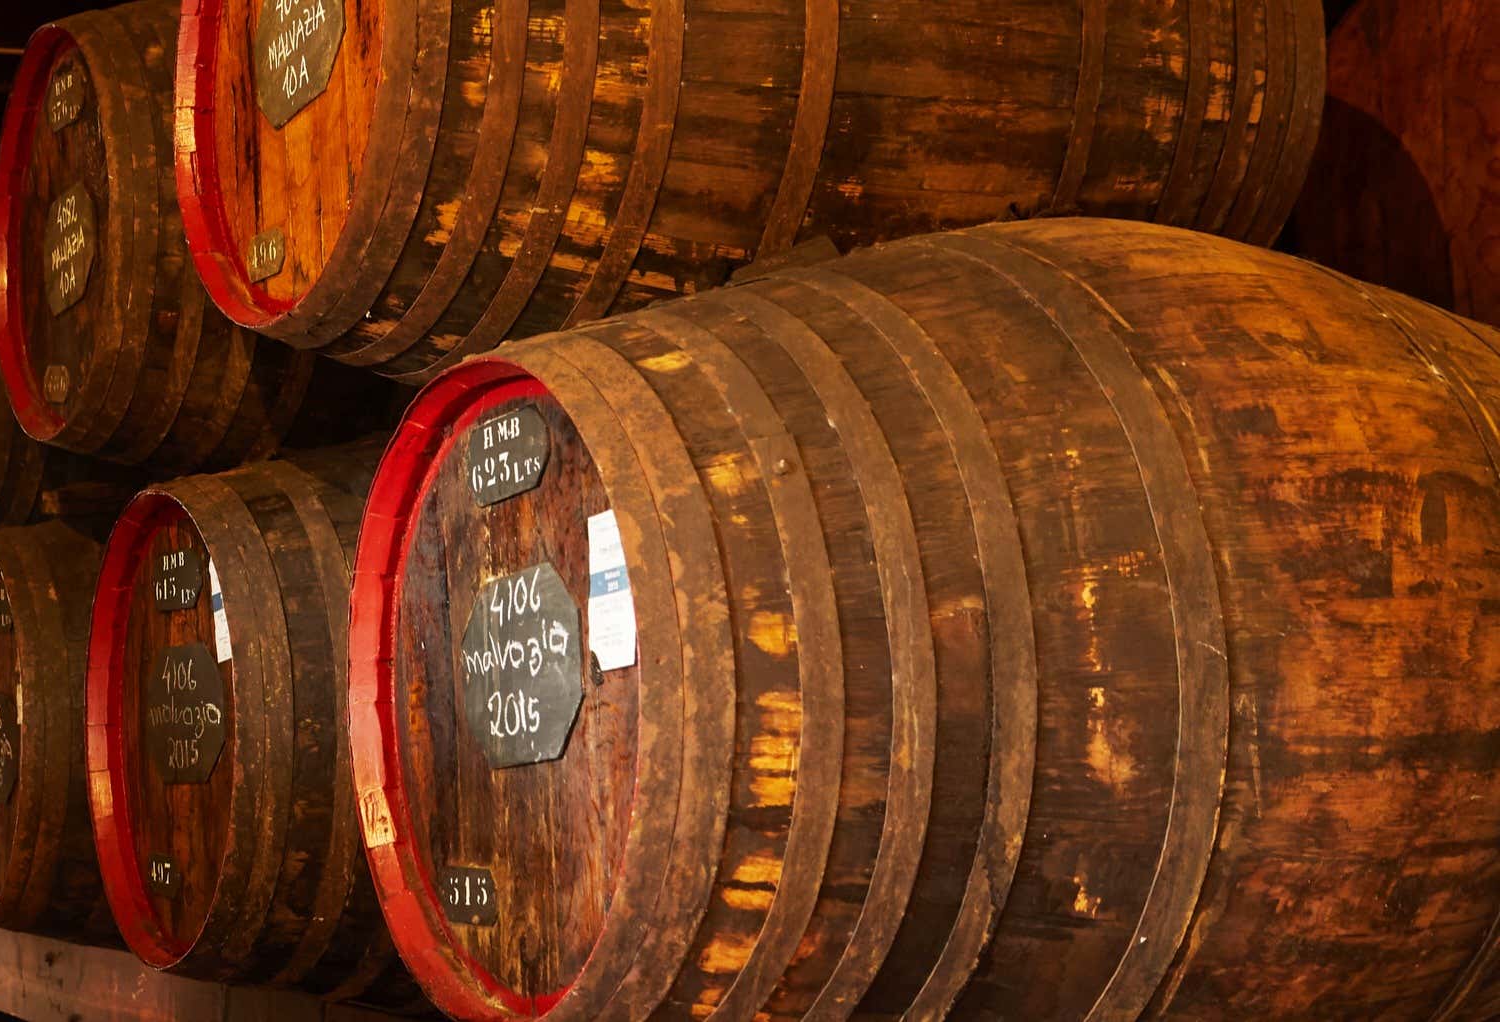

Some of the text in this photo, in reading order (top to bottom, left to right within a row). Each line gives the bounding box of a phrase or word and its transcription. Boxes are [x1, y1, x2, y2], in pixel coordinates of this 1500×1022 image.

[276, 0, 299, 23] 40
[268, 0, 326, 71] MALVAZIA
[472, 451, 511, 493] 623
[490, 567, 541, 627] 4106
[162, 655, 198, 694] 4106
[487, 689, 541, 738] 2015
[168, 737, 200, 769] 2015
[151, 861, 171, 885] 497
[449, 876, 488, 906] 515
